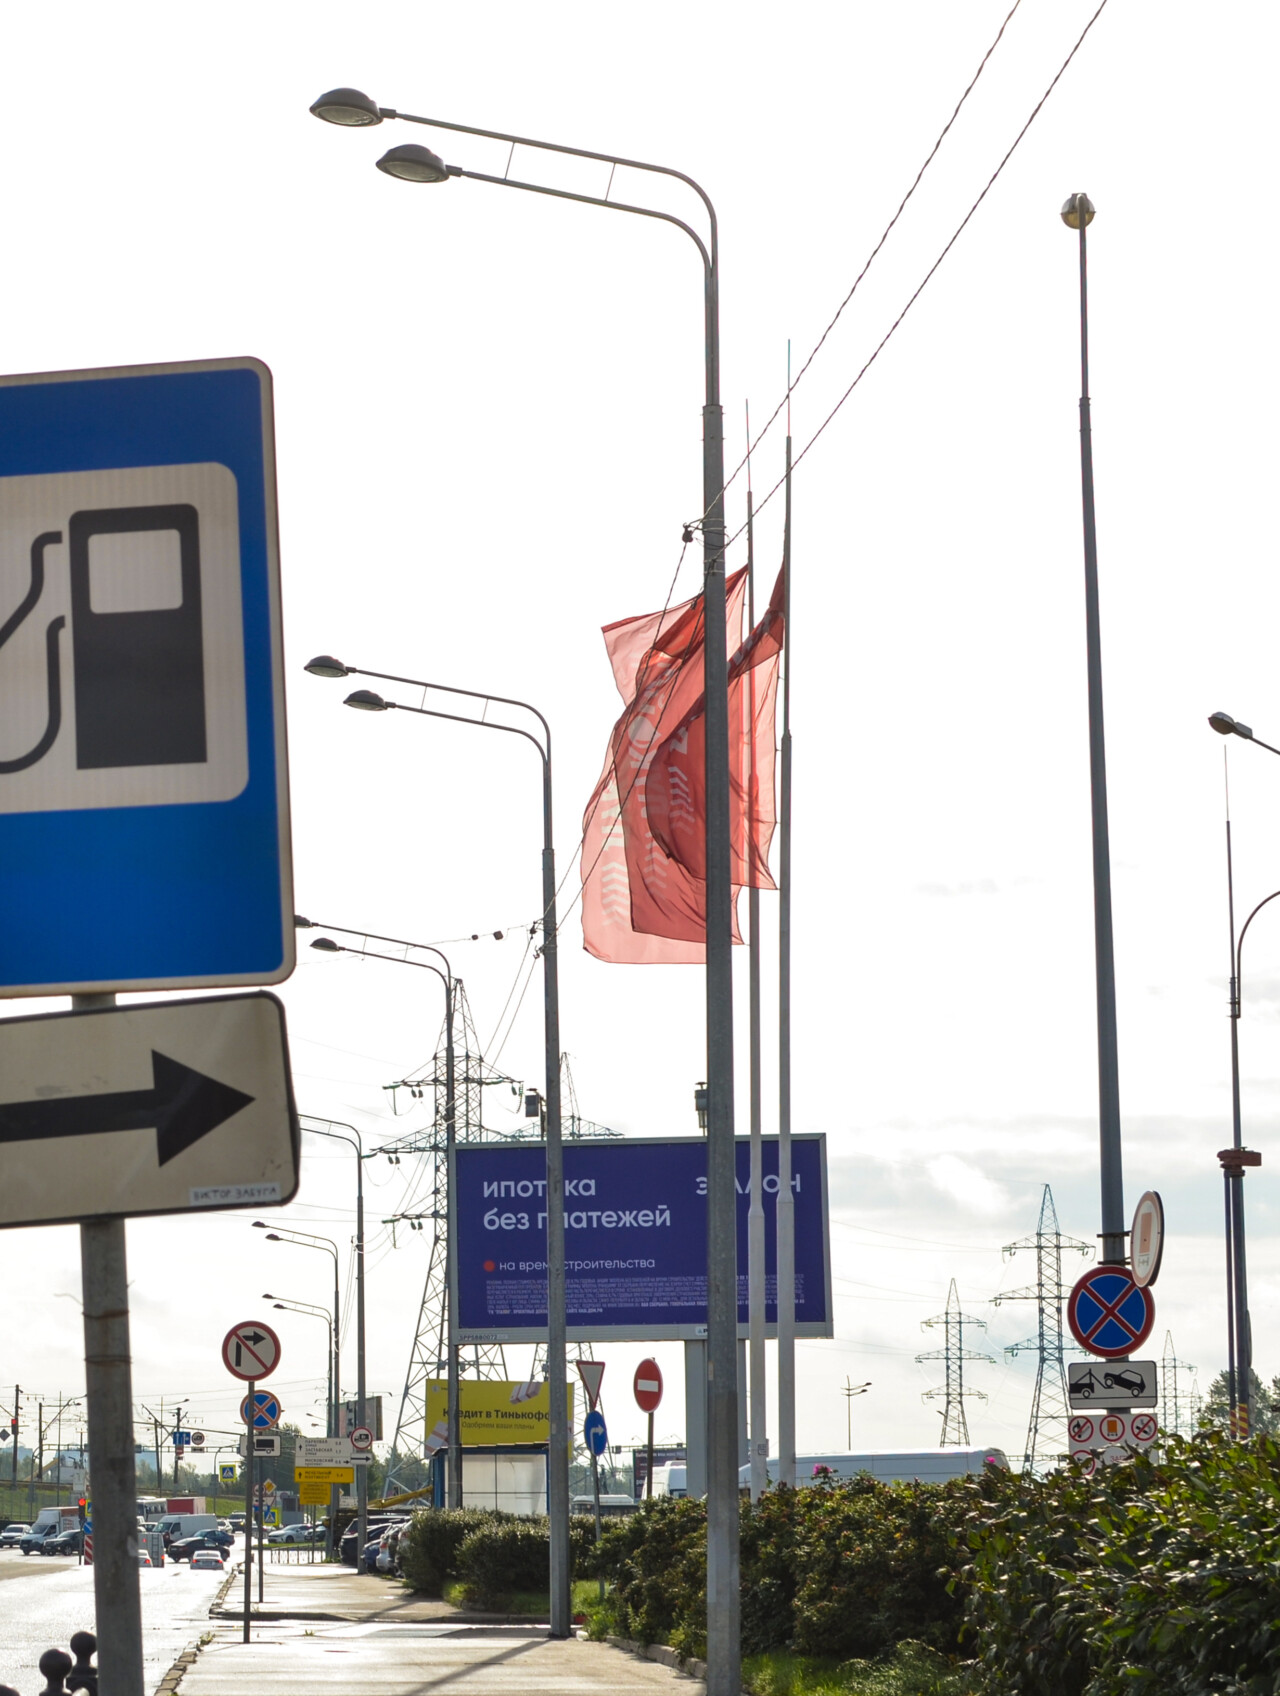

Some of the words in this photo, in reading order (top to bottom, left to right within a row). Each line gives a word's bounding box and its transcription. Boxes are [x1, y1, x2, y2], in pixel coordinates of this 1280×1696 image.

[483, 1179, 596, 1198] ипотка
[483, 1207, 530, 1230] без
[538, 1205, 671, 1229] патежей
[499, 1261, 516, 1270] на
[520, 1260, 549, 1274] врем
[443, 1408, 483, 1419] Кедит
